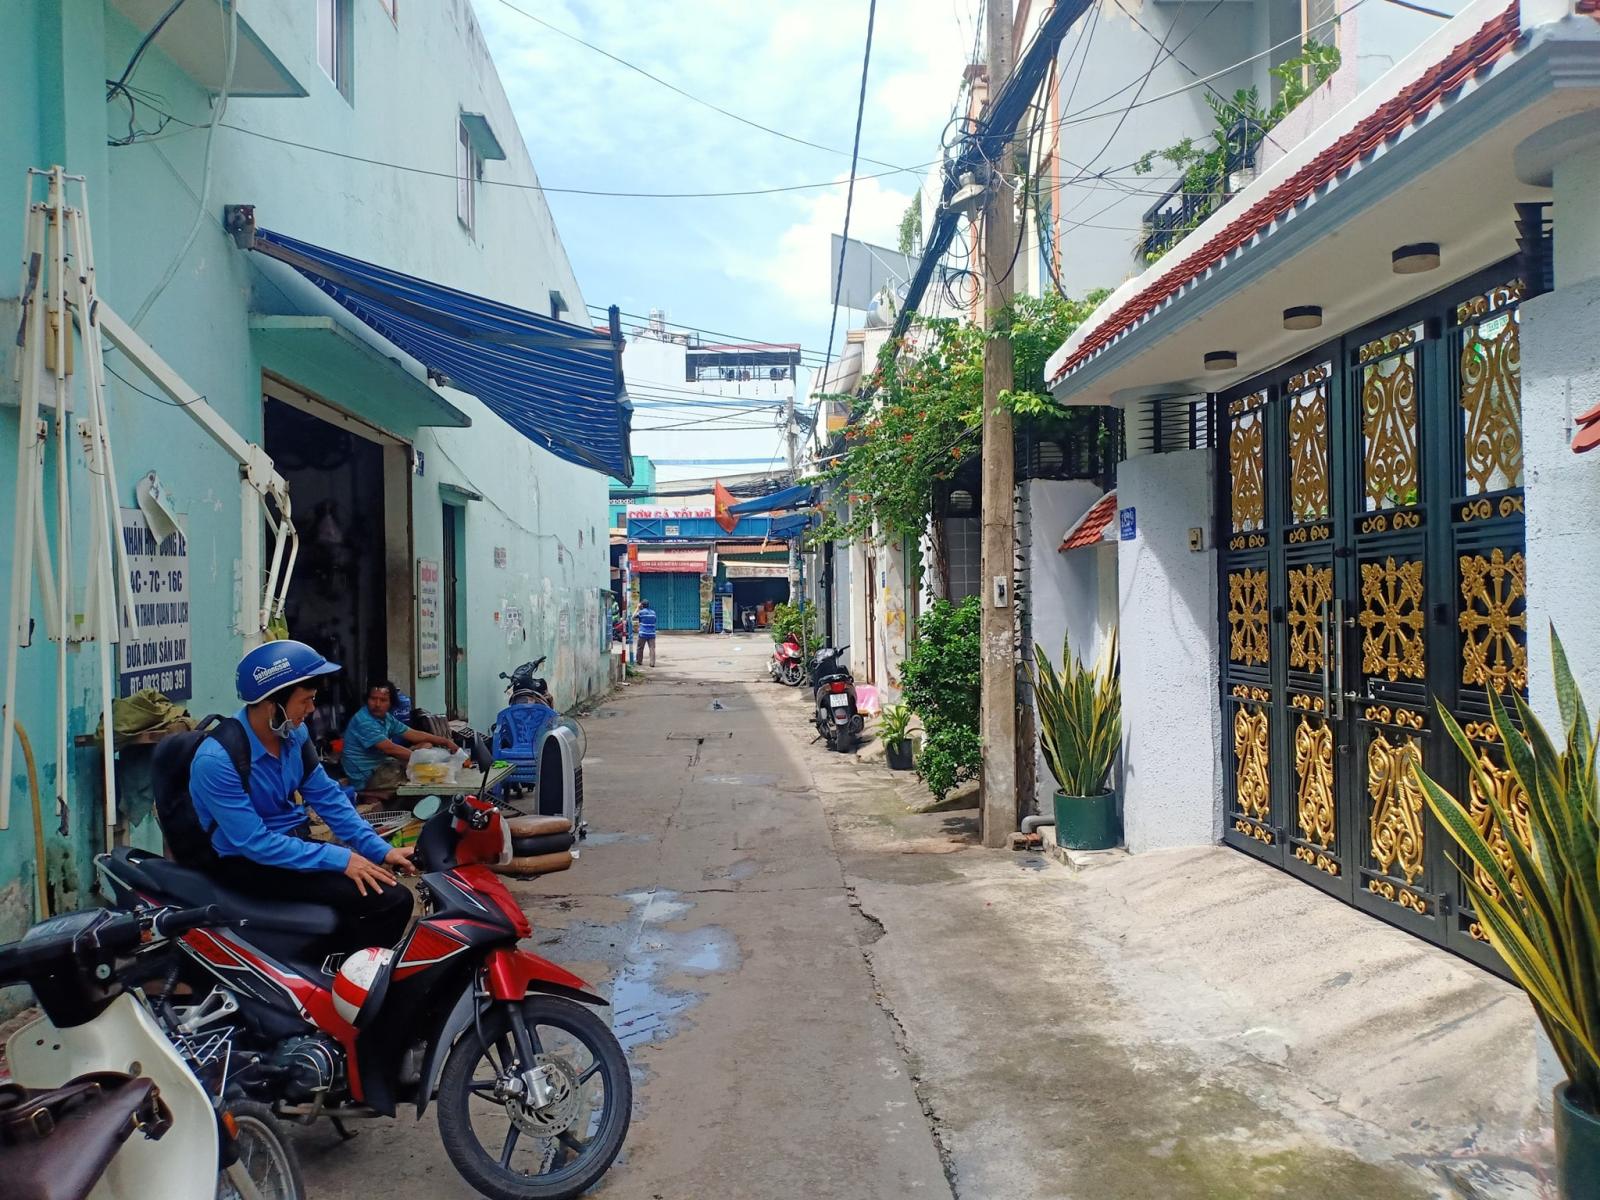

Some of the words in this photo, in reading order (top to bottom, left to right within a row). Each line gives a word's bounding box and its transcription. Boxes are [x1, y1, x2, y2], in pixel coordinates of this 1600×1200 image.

[123, 521, 143, 562] NHẬN
[149, 570, 160, 592] 7C
[168, 570, 183, 592] 16C
[143, 637, 157, 666] ĐÓN
[174, 638, 187, 661] BAY
